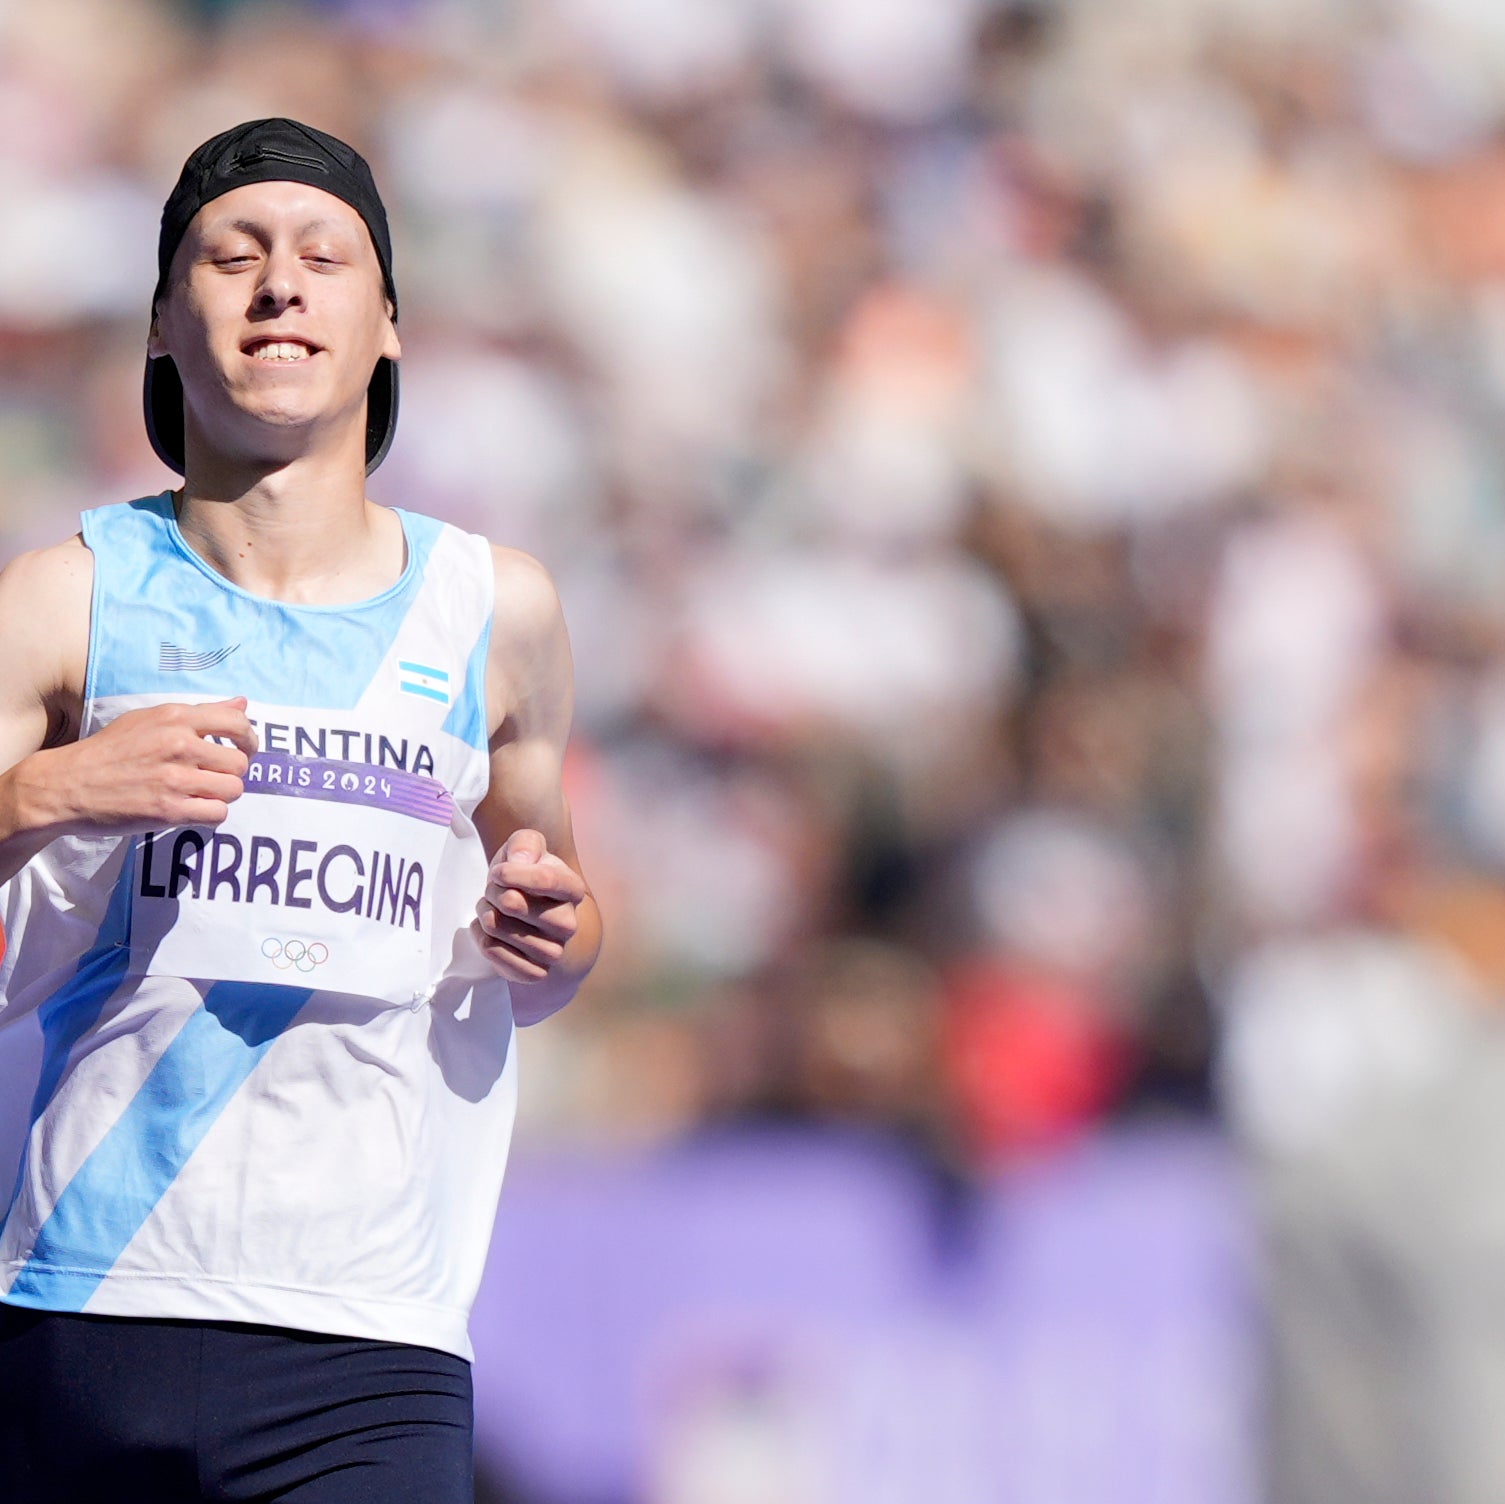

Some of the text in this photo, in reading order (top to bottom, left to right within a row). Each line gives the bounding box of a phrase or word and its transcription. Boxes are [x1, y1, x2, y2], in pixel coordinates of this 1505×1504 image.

[214, 719, 434, 778] ENTINA
[248, 762, 392, 799] ARIS 2024
[140, 829, 424, 932] LARREGINA
